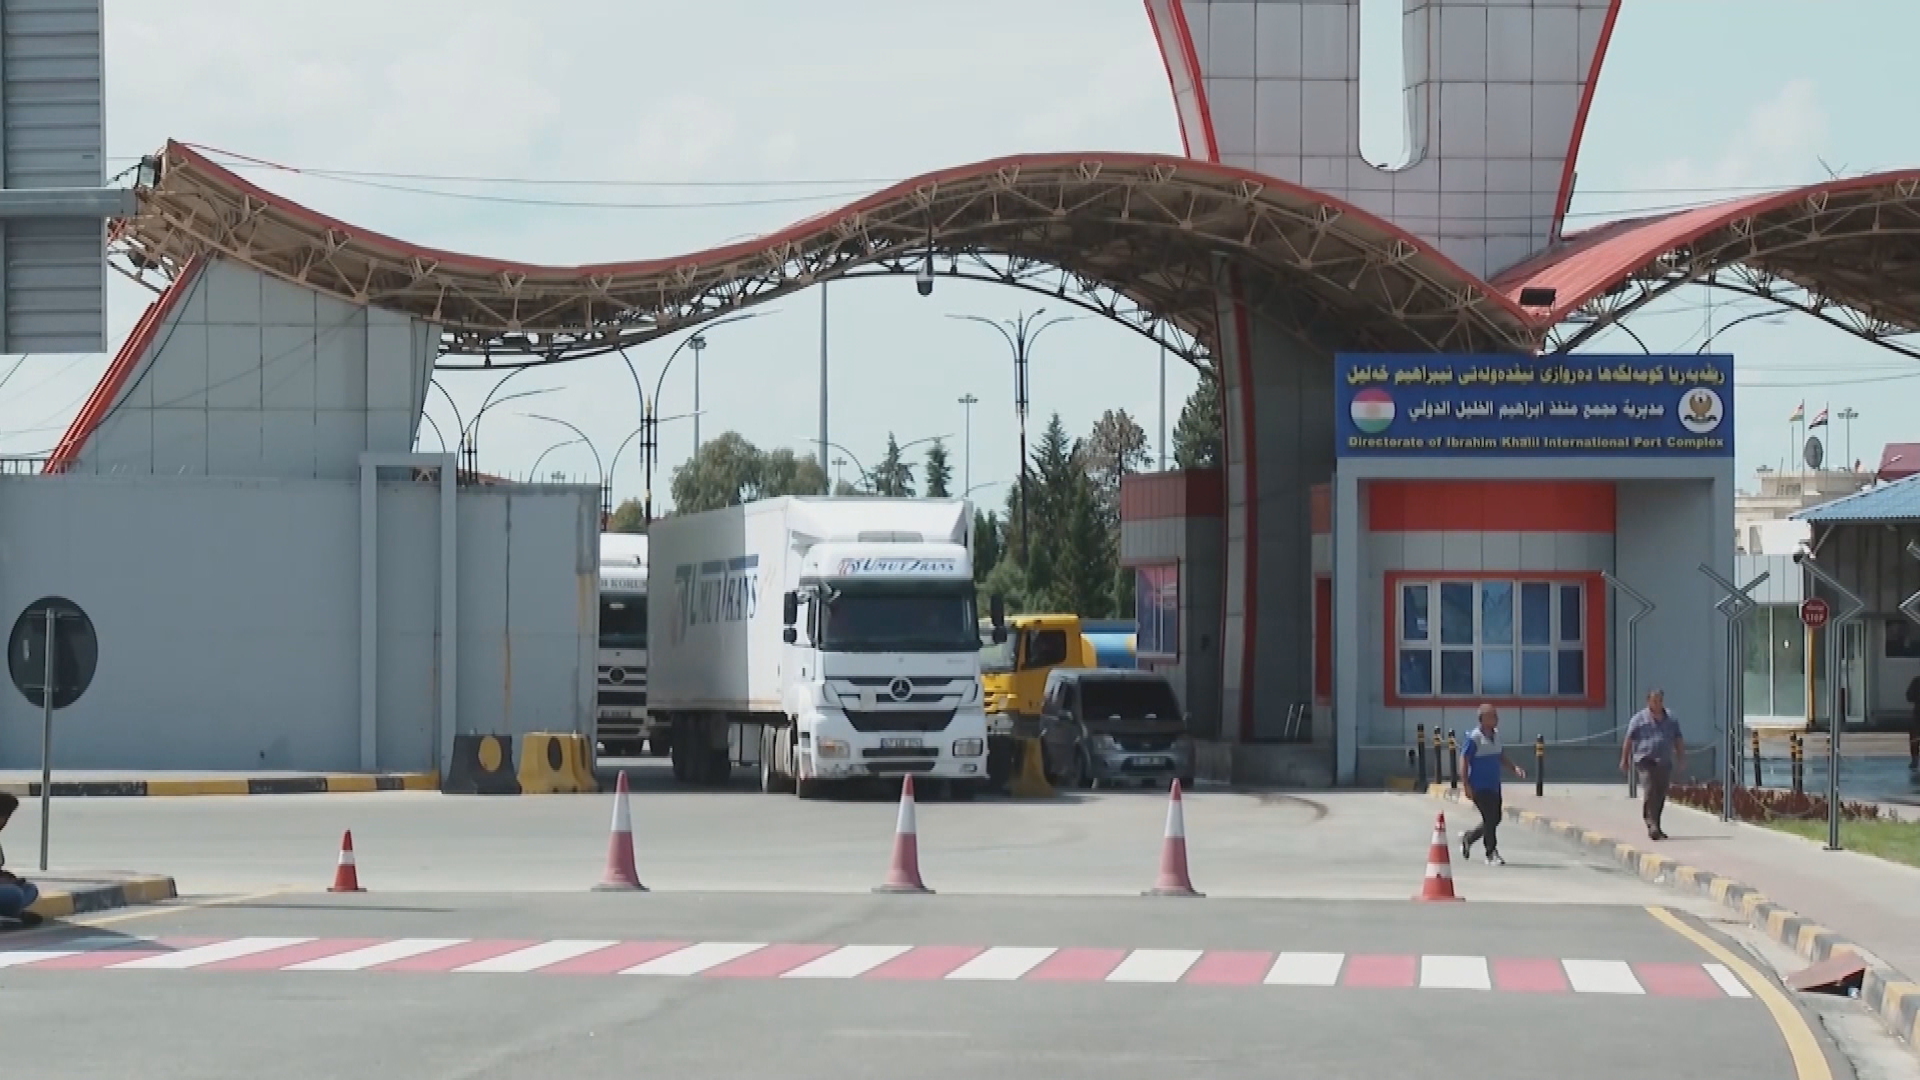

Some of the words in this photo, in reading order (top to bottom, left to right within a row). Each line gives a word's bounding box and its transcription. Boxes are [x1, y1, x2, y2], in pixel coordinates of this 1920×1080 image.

[1455, 400, 1494, 419] الخليل
[1549, 401, 1579, 416] منفذ
[1583, 403, 1617, 419] مجمع
[1622, 399, 1666, 419] مديرية
[1348, 437, 1425, 448] Directorate
[1428, 436, 1443, 448] of
[1446, 436, 1497, 448] Ibrahim
[1502, 436, 1540, 448] Khalil
[1544, 436, 1630, 448] International
[1634, 437, 1662, 448] Port
[1666, 436, 1724, 449] Complex
